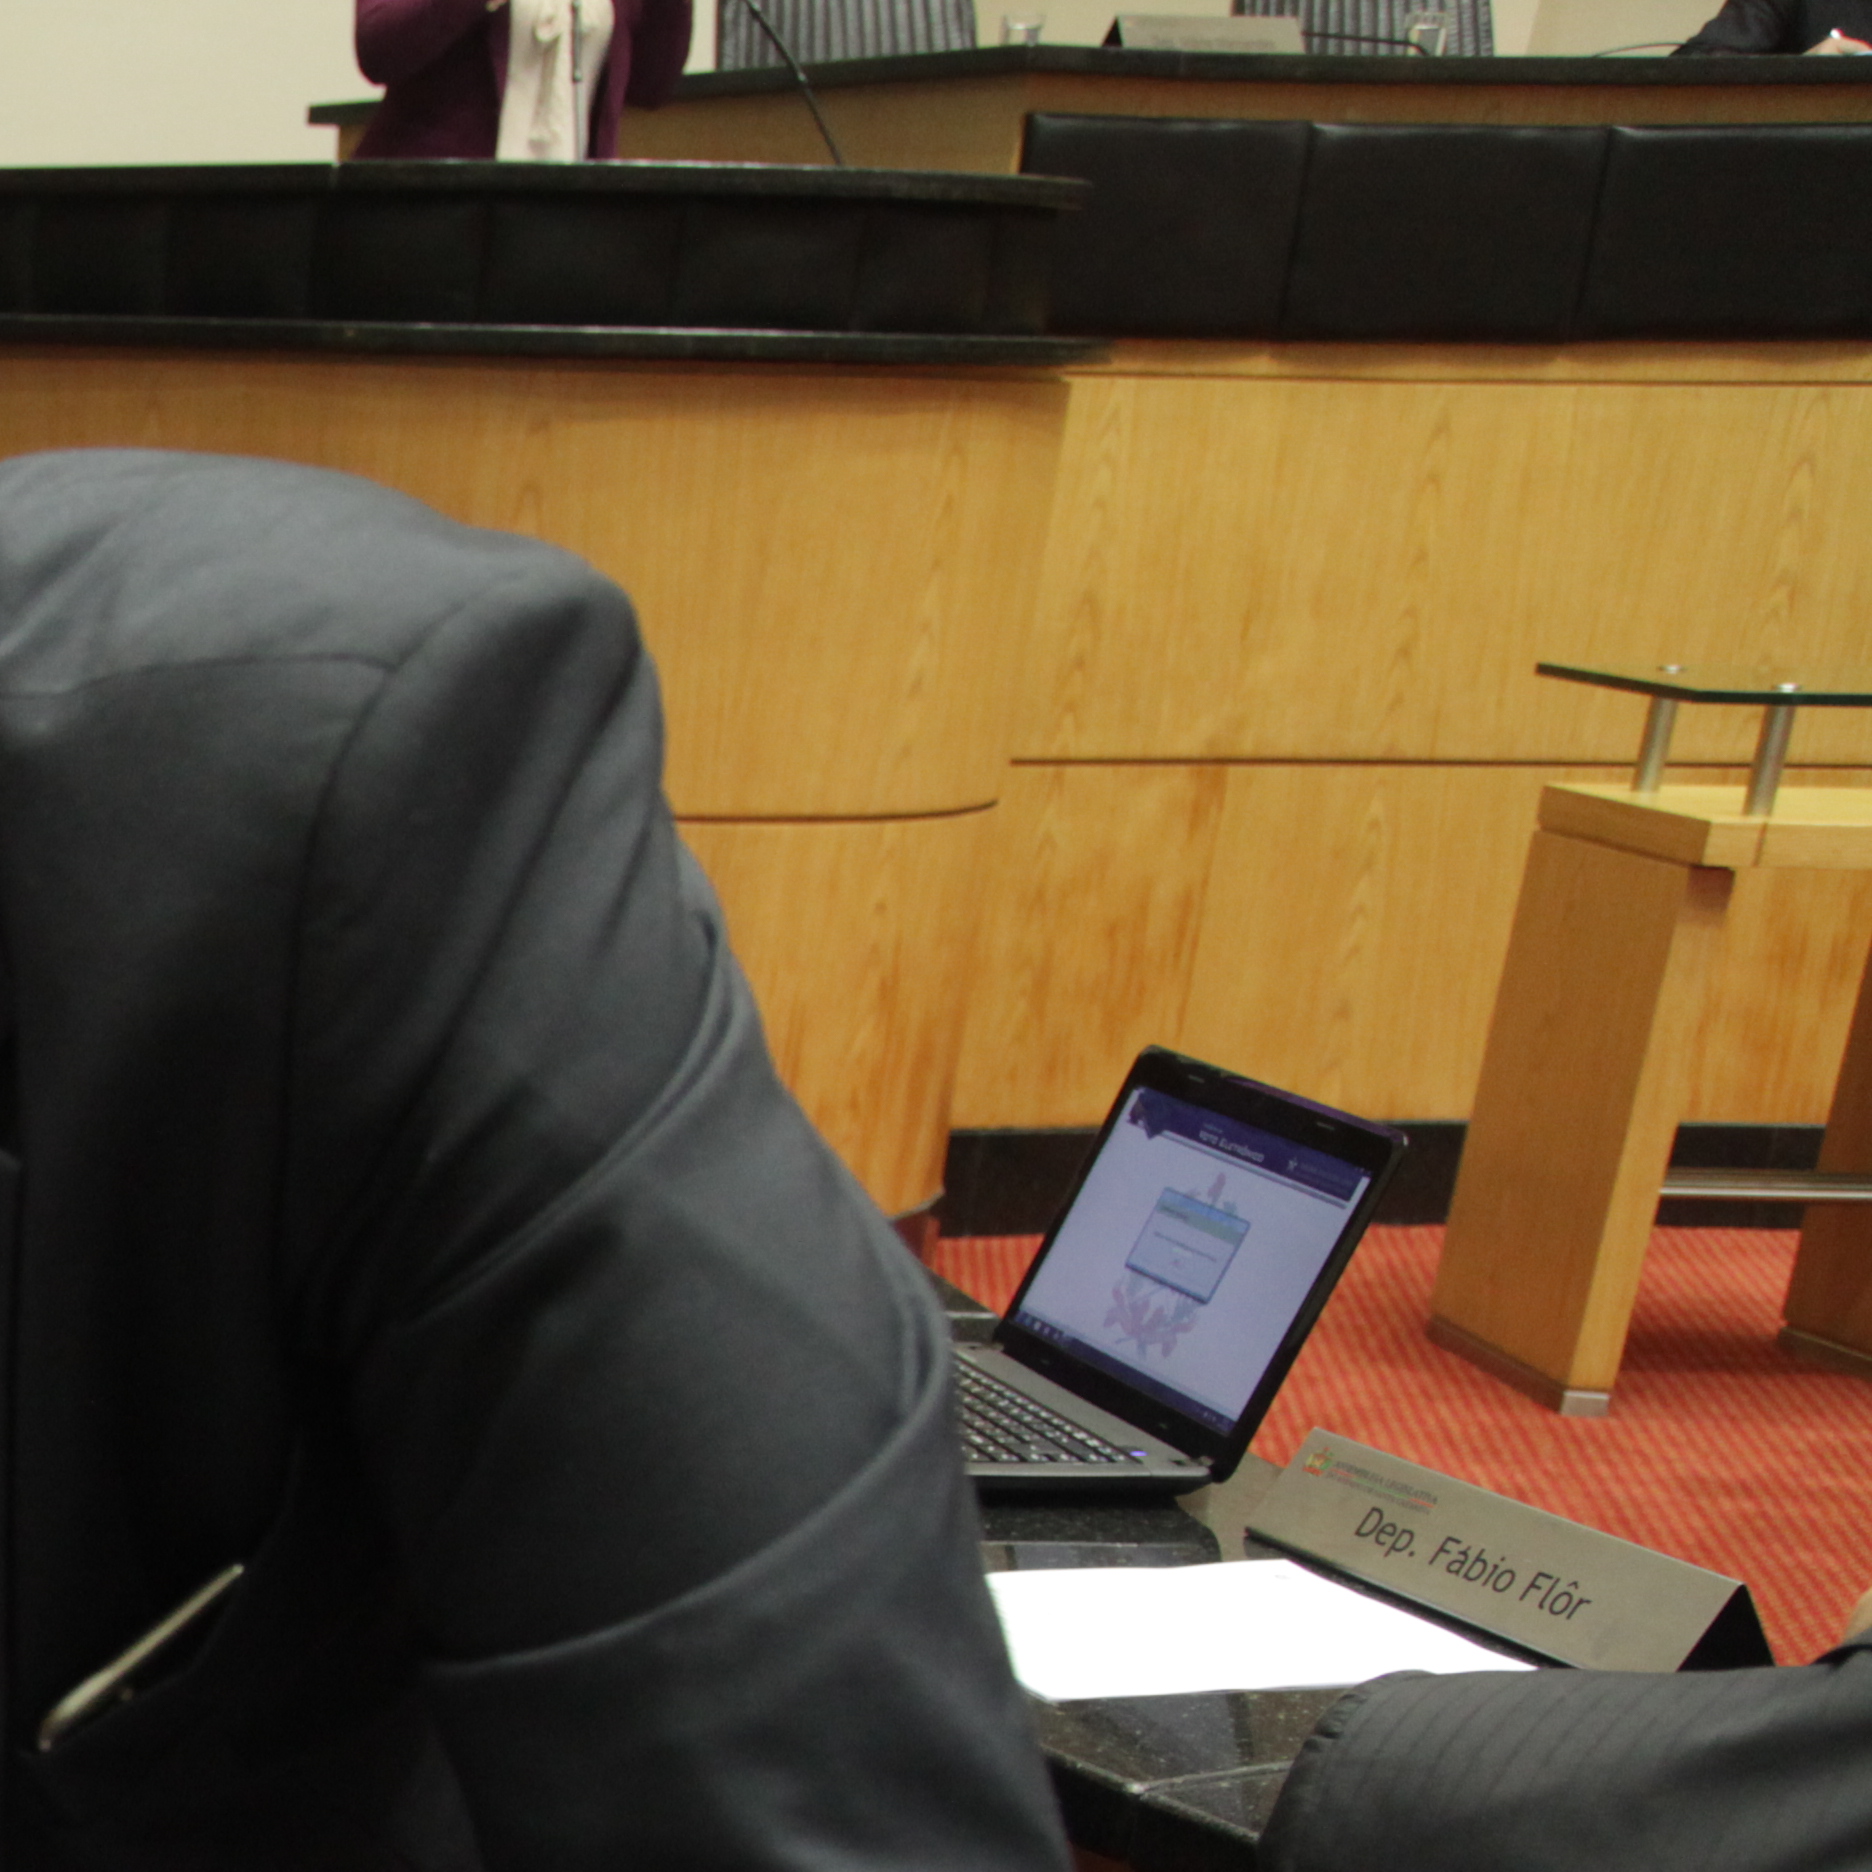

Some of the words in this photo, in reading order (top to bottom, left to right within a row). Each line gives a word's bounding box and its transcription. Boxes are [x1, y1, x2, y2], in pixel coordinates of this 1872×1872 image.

[1354, 1506, 1415, 1558] Dep.
[1428, 1536, 1516, 1593] Fábio
[1519, 1571, 1592, 1620] Flôr
